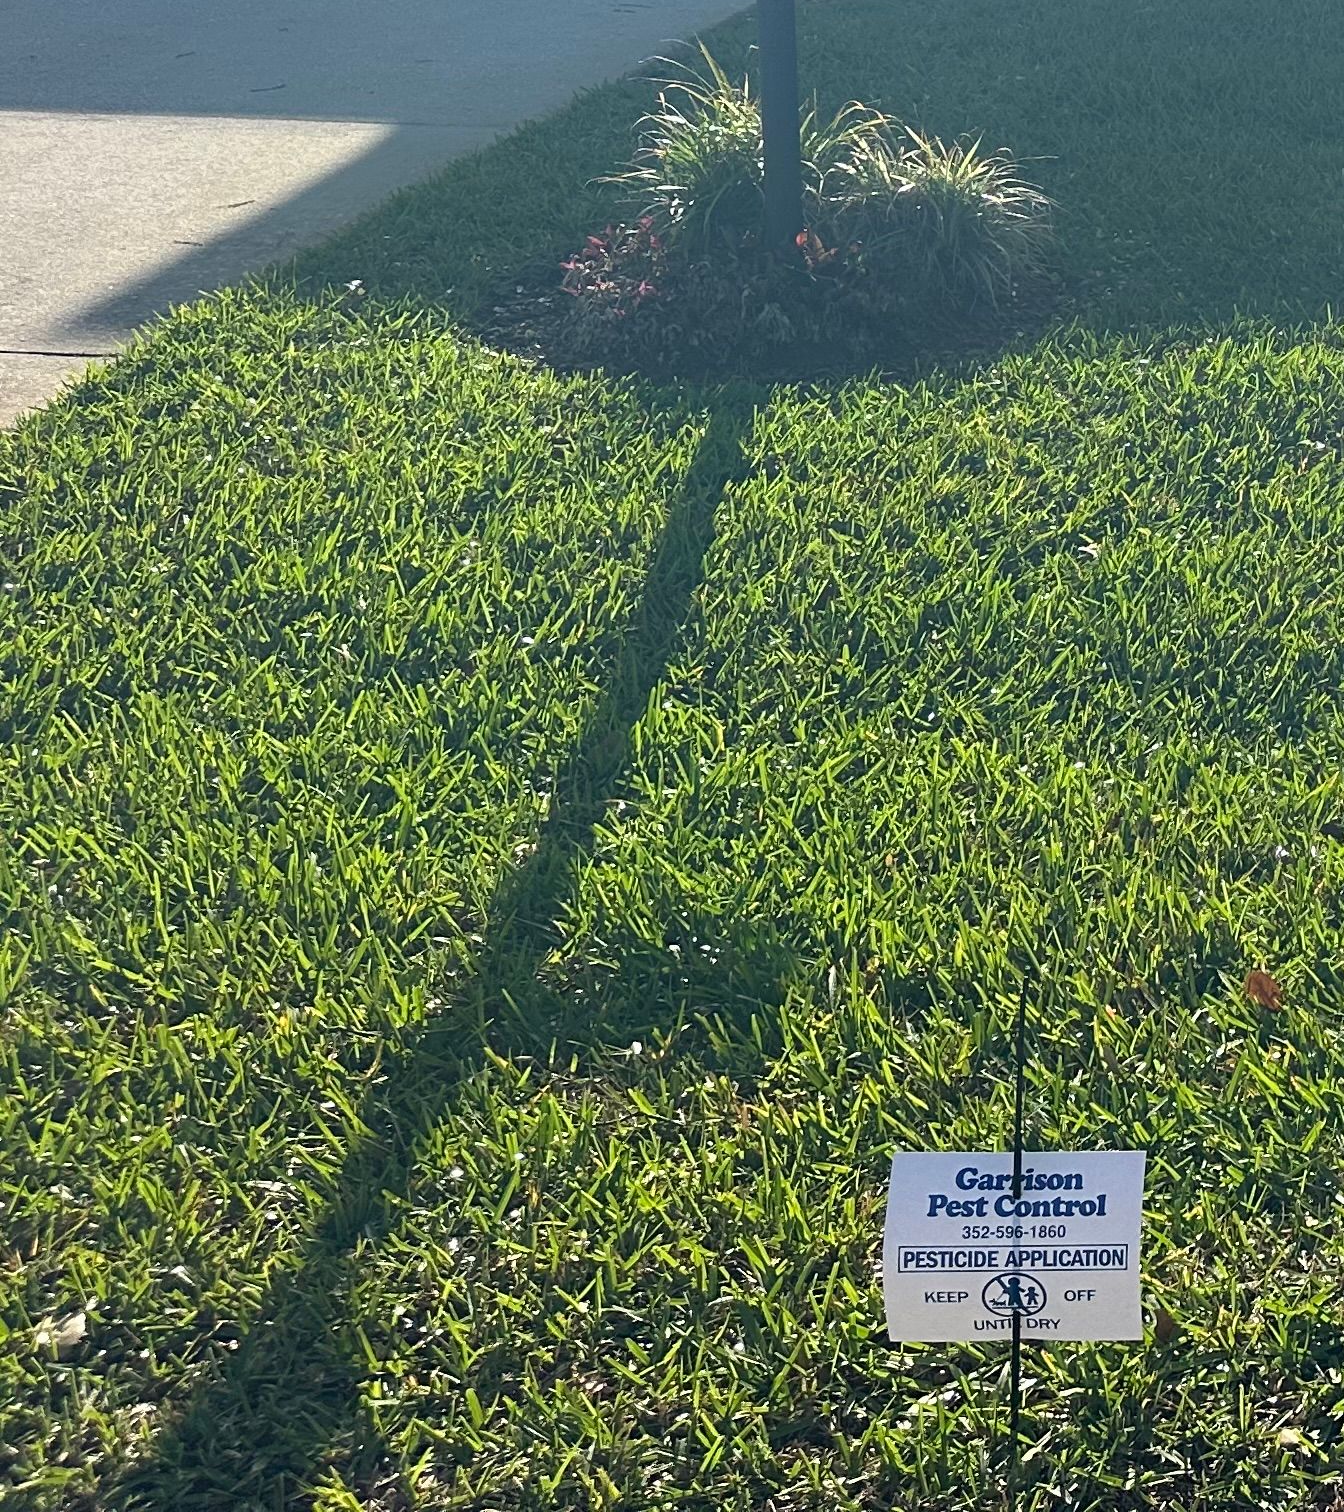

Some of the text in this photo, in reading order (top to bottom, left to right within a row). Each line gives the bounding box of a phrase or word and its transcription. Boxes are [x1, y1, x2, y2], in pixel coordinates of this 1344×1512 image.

[927, 1194, 1106, 1217] Pest Control
[962, 1225, 1066, 1239] 352-596-1860
[903, 1249, 1124, 1268] PESTICIDE APPLICATION
[924, 1289, 1096, 1303] KEEP OFF
[974, 1318, 1061, 1330] UNTI DRY
